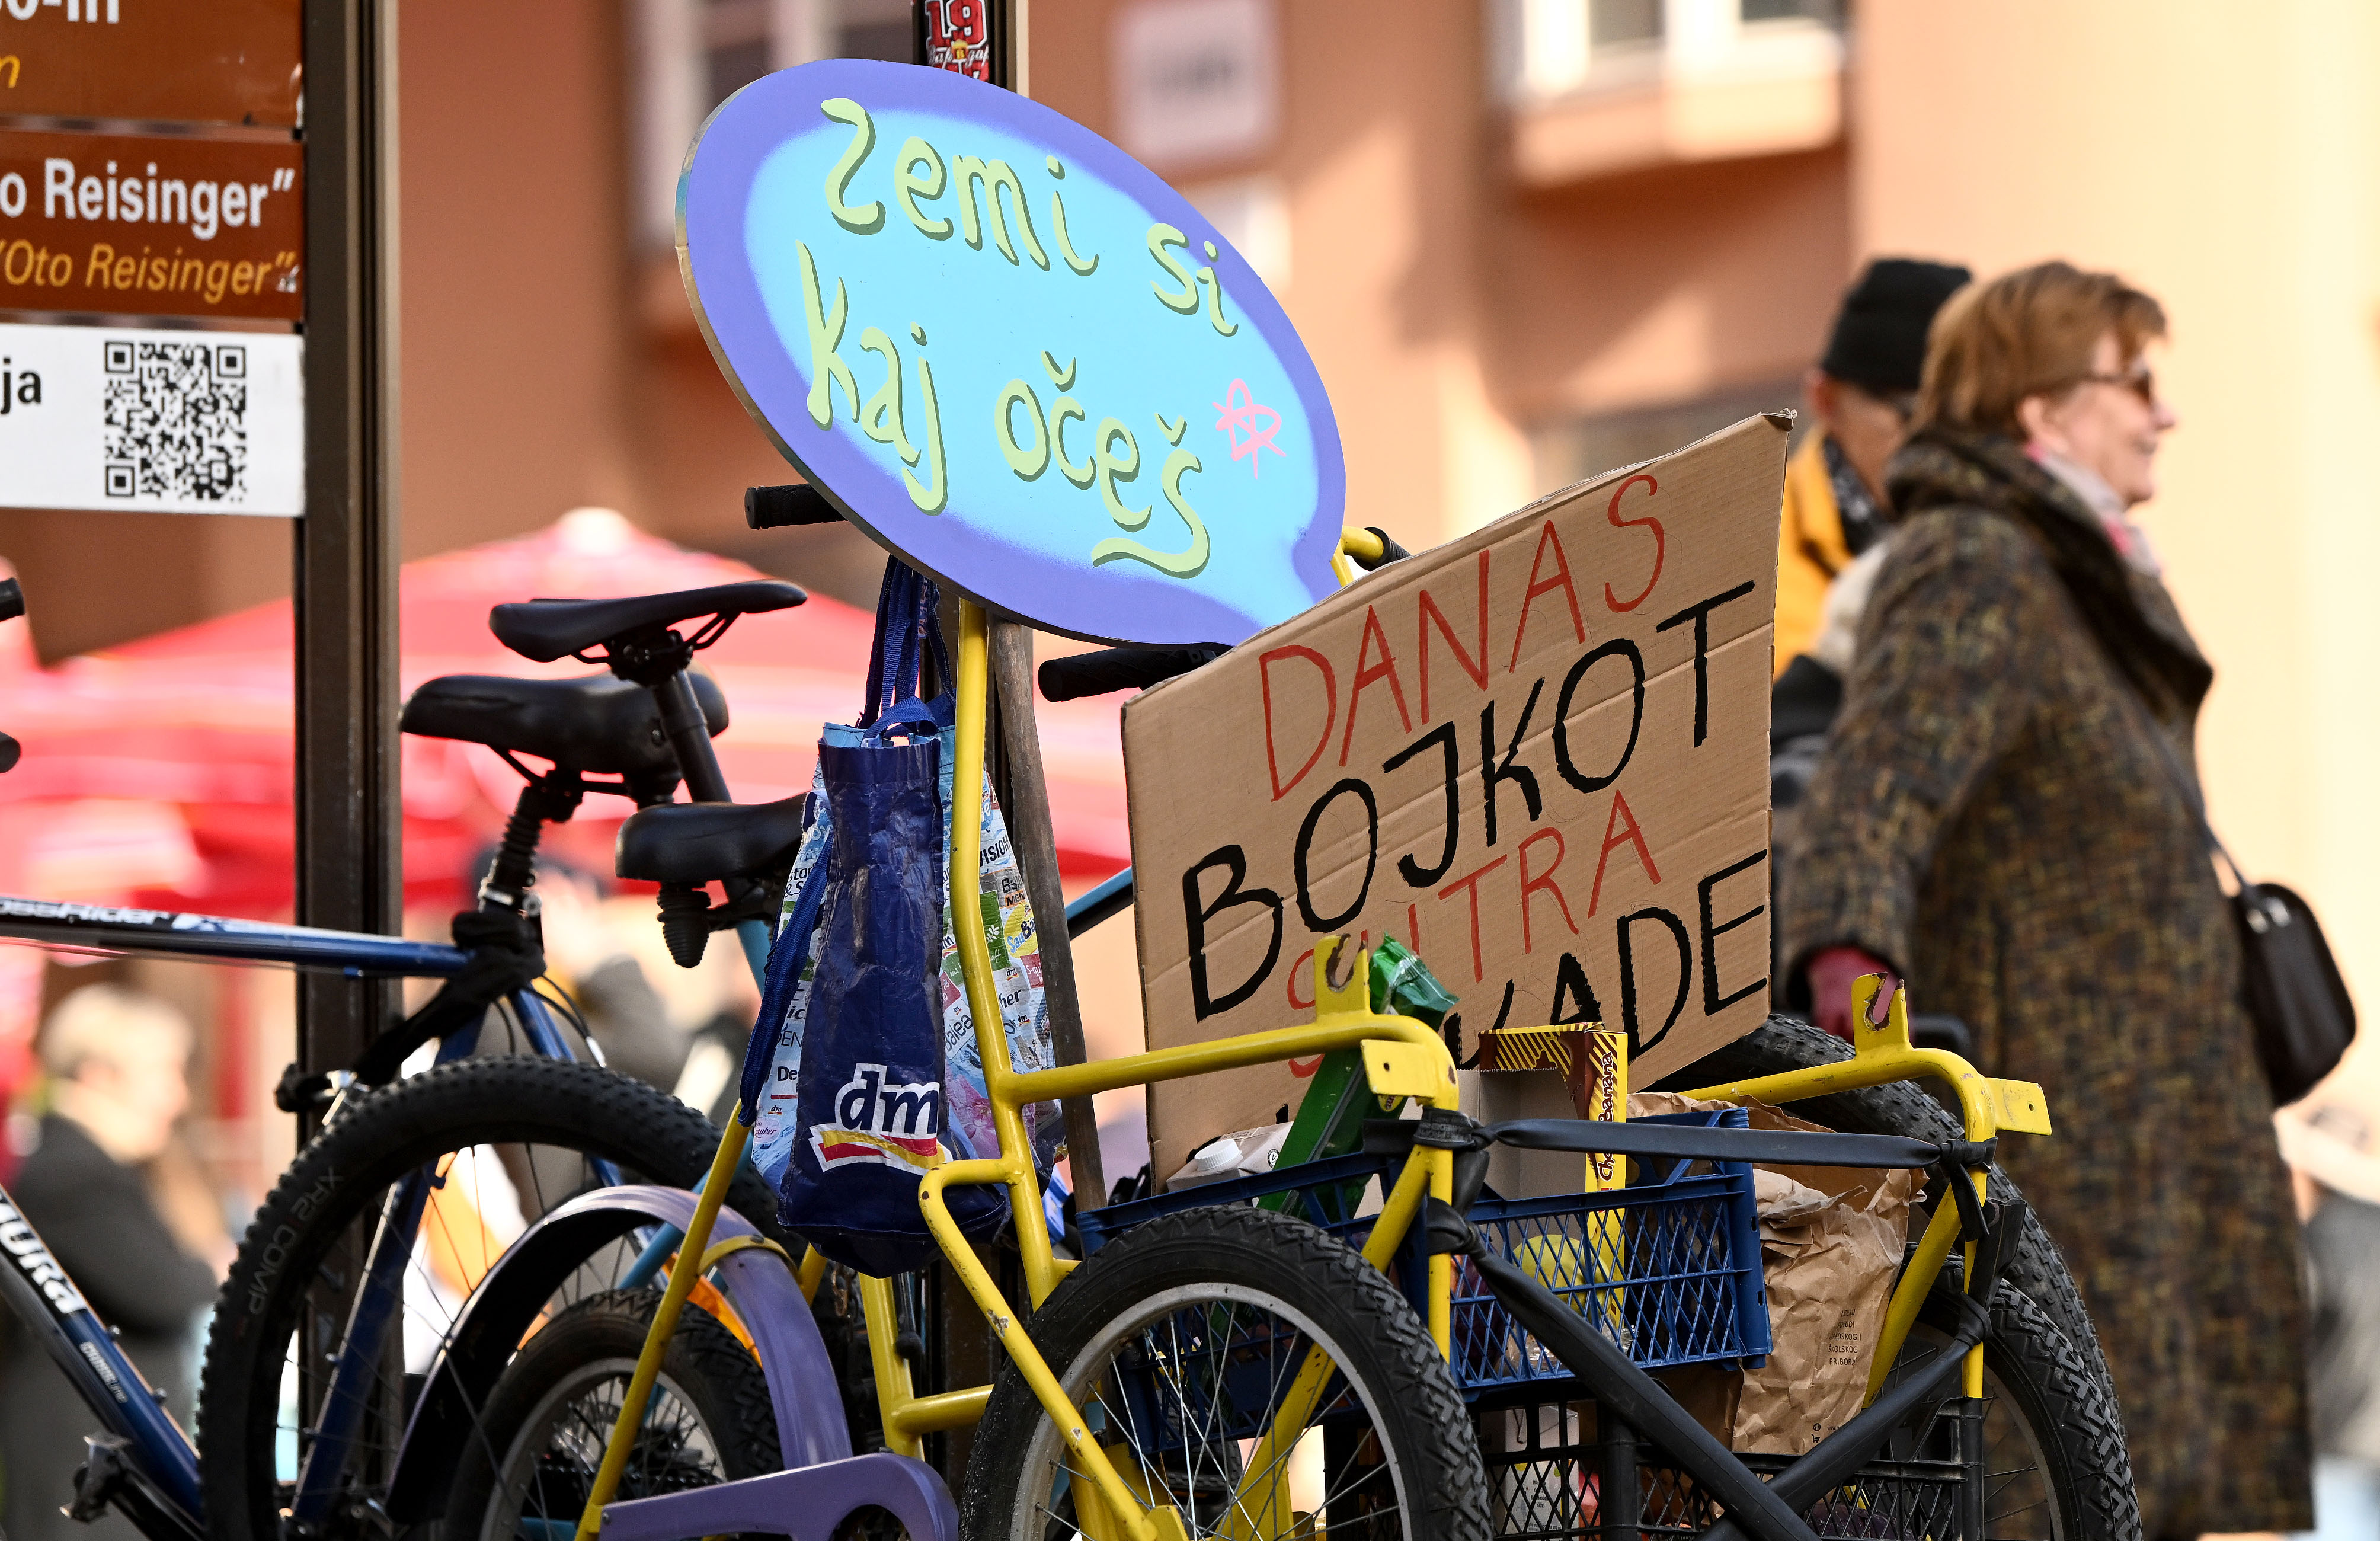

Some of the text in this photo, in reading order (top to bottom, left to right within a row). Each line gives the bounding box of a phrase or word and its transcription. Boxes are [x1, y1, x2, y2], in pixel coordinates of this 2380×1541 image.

[925, 0, 988, 52] 19
[1146, 222, 1239, 337] si
[993, 349, 1211, 579] očeš
[1258, 474, 1665, 802] DANAS
[1183, 580, 1755, 1024] BOJKOT
[1007, 968, 1016, 977] dm
[1287, 789, 1661, 1078] STRA
[839, 1069, 939, 1134] dm
[248, 1223, 299, 1315] COMP
[1828, 1344, 1858, 1353] ŠKOLSKOG
